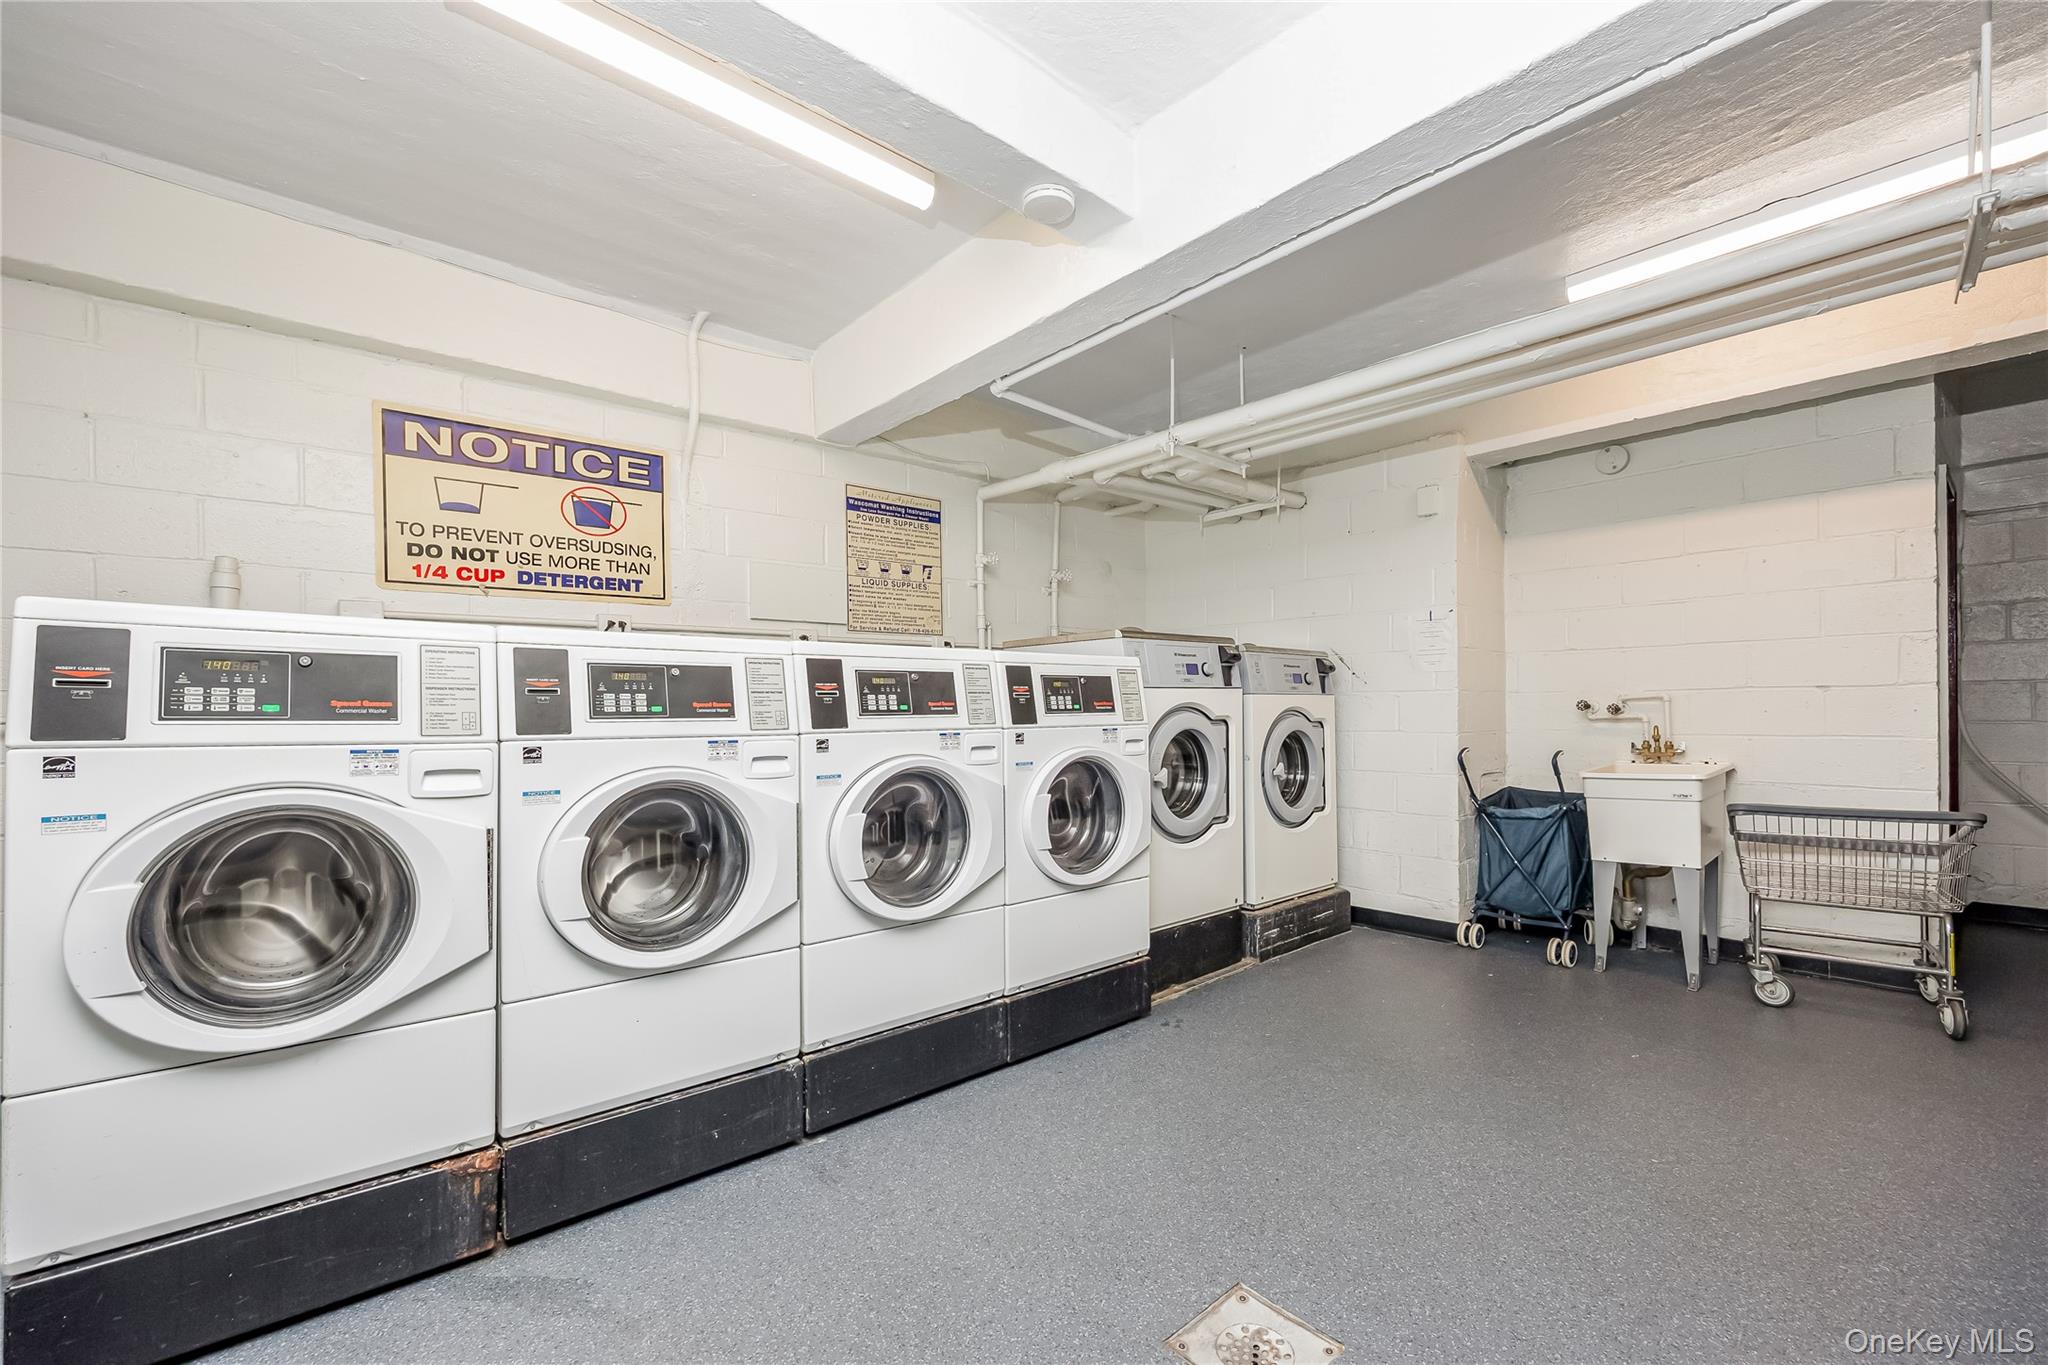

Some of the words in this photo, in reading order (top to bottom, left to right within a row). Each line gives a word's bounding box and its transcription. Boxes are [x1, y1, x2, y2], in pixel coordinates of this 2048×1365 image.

[403, 420, 650, 486] NOTICE
[848, 498, 879, 508] Wascomat
[880, 502, 905, 513] Washing
[906, 505, 939, 518] Instructions
[856, 513, 890, 525] POWDER
[893, 519, 931, 531] SUPPLIES:
[395, 521, 425, 537] TO
[432, 524, 523, 546] PREVENT
[529, 534, 657, 562] OVERSUDSING,
[407, 542, 443, 559] DO
[451, 545, 500, 563] NOT
[506, 551, 542, 567] USE
[549, 555, 600, 571] MORE
[605, 559, 651, 576] THAN
[411, 564, 448, 580] 1/4
[456, 566, 505, 583] CUP
[517, 570, 643, 593] DETERGENT
[861, 578, 888, 587] LIQUID
[891, 581, 929, 590] SUPPLIES:
